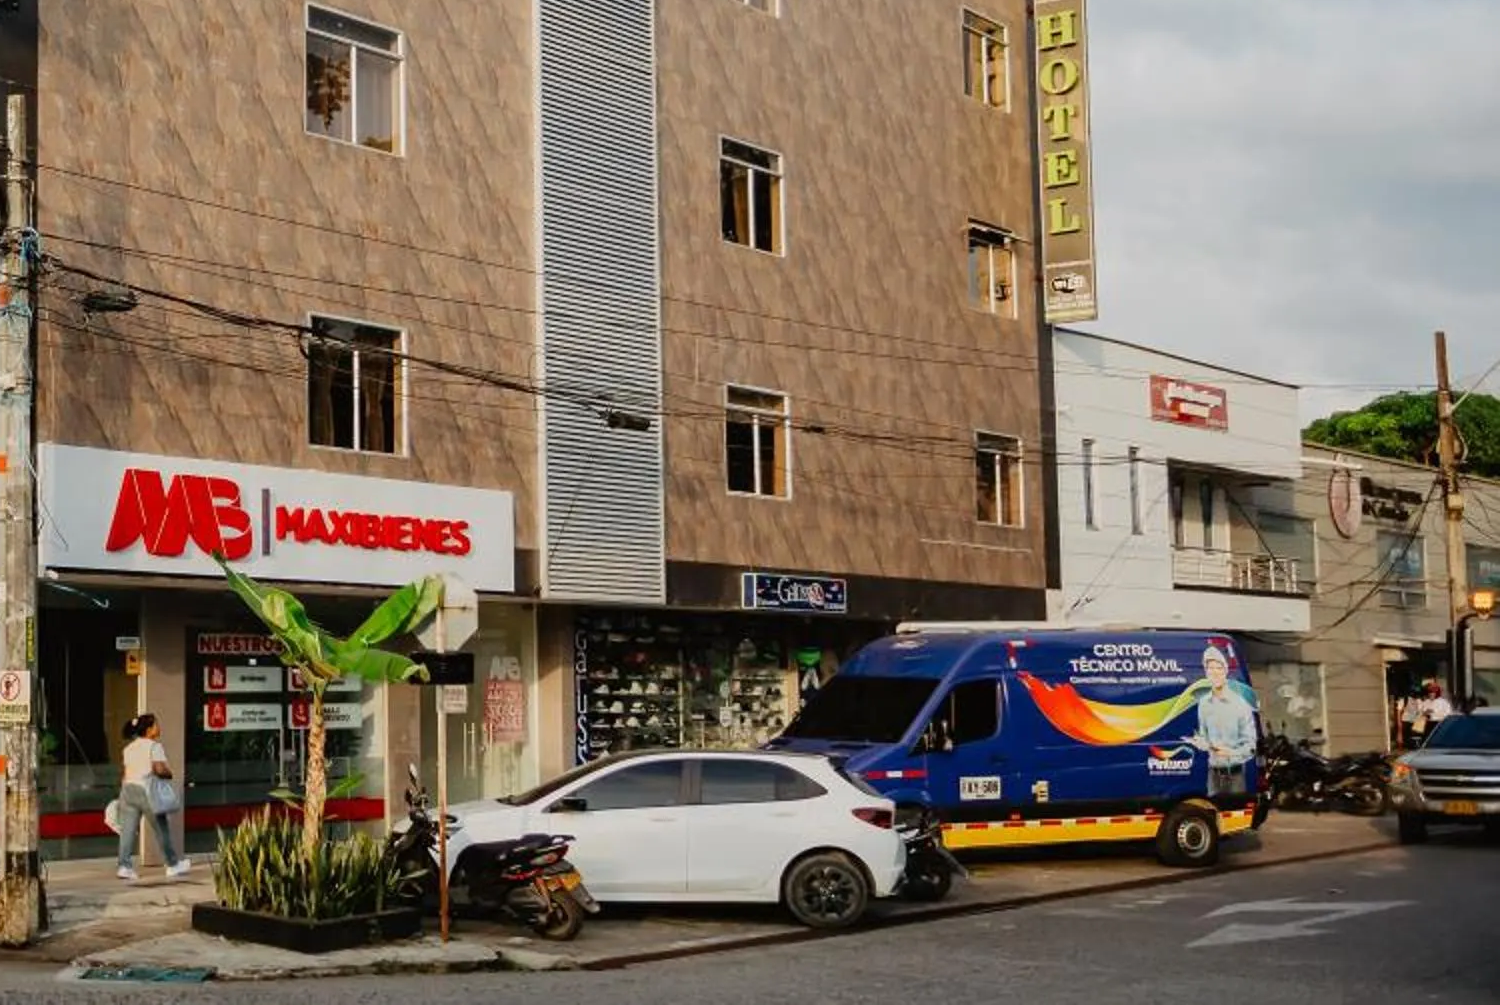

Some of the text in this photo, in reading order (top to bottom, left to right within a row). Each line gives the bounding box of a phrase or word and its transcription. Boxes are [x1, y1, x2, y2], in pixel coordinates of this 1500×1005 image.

[1038, 11, 1081, 235] HOTEL
[276, 505, 471, 556] MAXIBIENES
[1070, 657, 1184, 672] TÉCNICO MÓVIL
[1093, 644, 1153, 656] CENTRO
